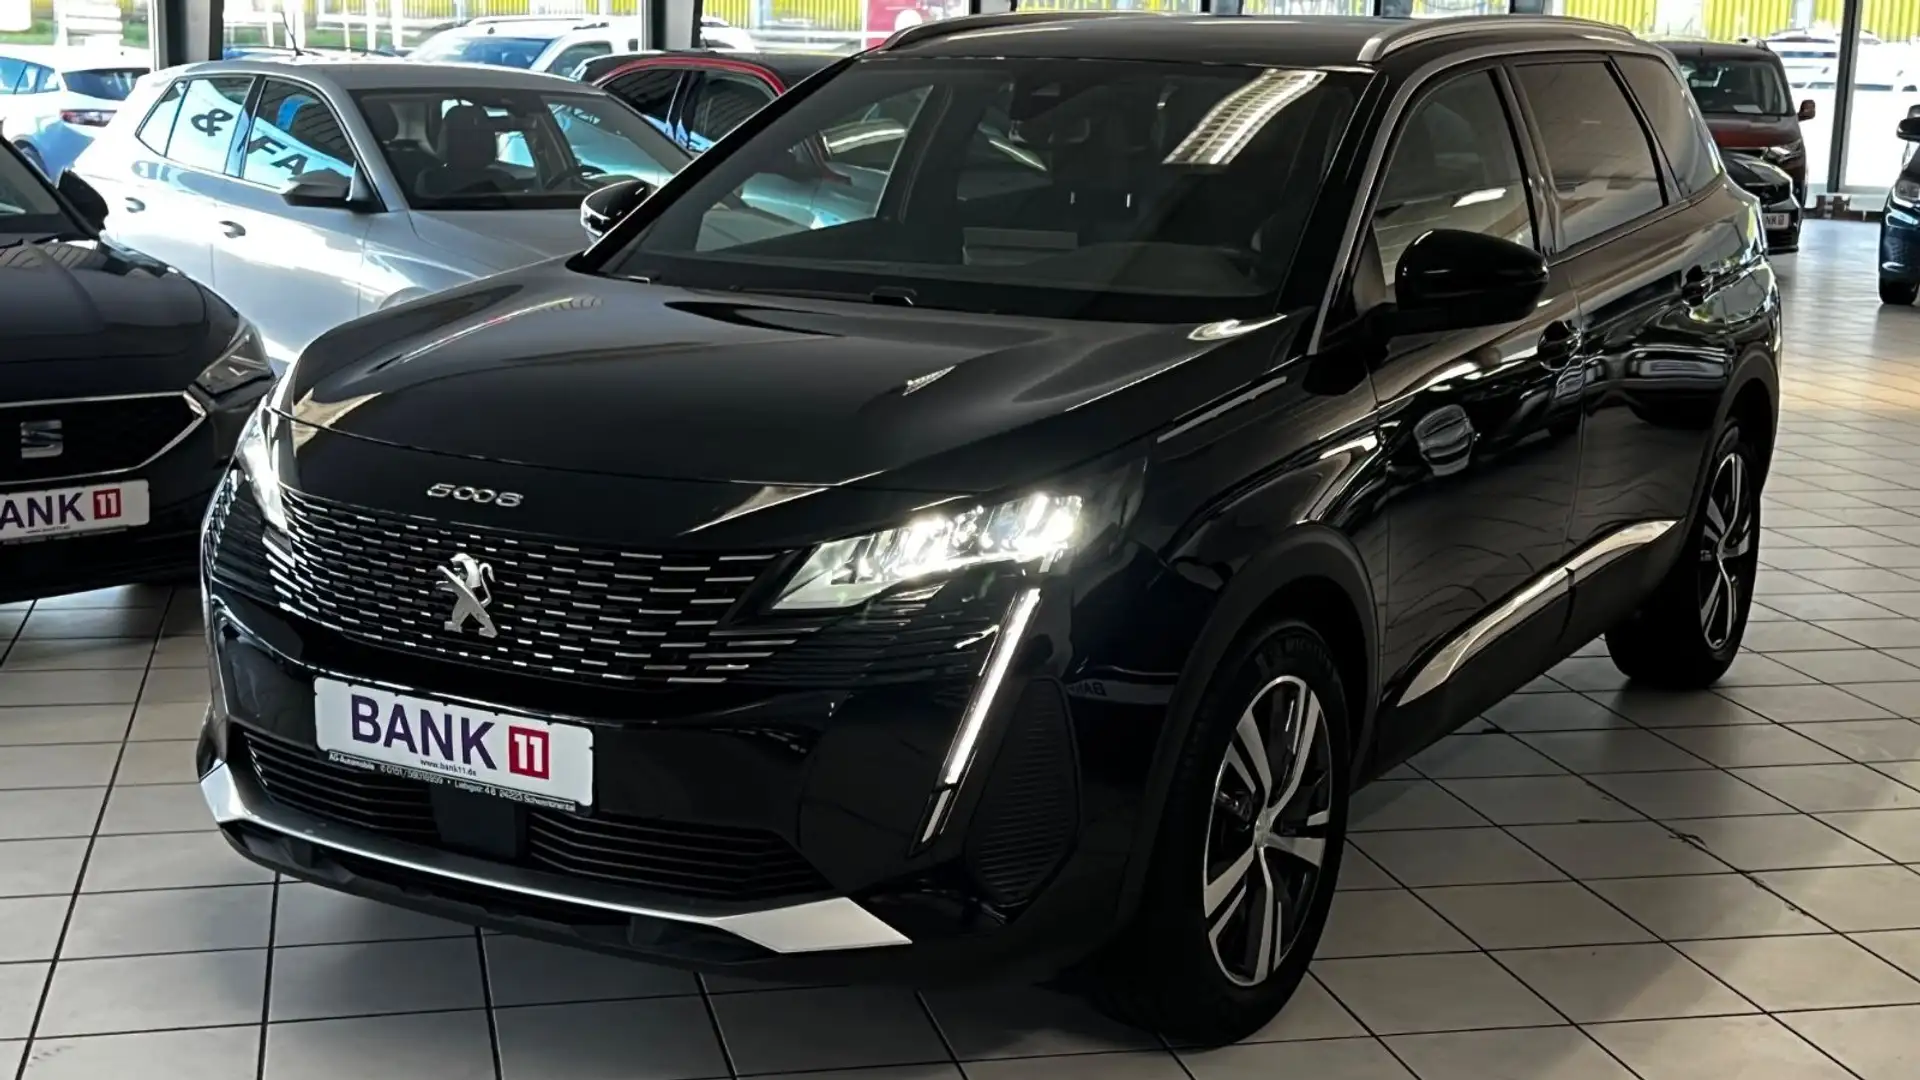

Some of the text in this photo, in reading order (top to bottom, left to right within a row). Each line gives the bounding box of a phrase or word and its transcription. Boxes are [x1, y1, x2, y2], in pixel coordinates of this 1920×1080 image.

[189, 107, 234, 137] &
[96, 492, 118, 516] 11
[426, 482, 524, 507] 5008
[351, 693, 545, 774] BANK 11
[420, 759, 477, 777] www.bank11.de
